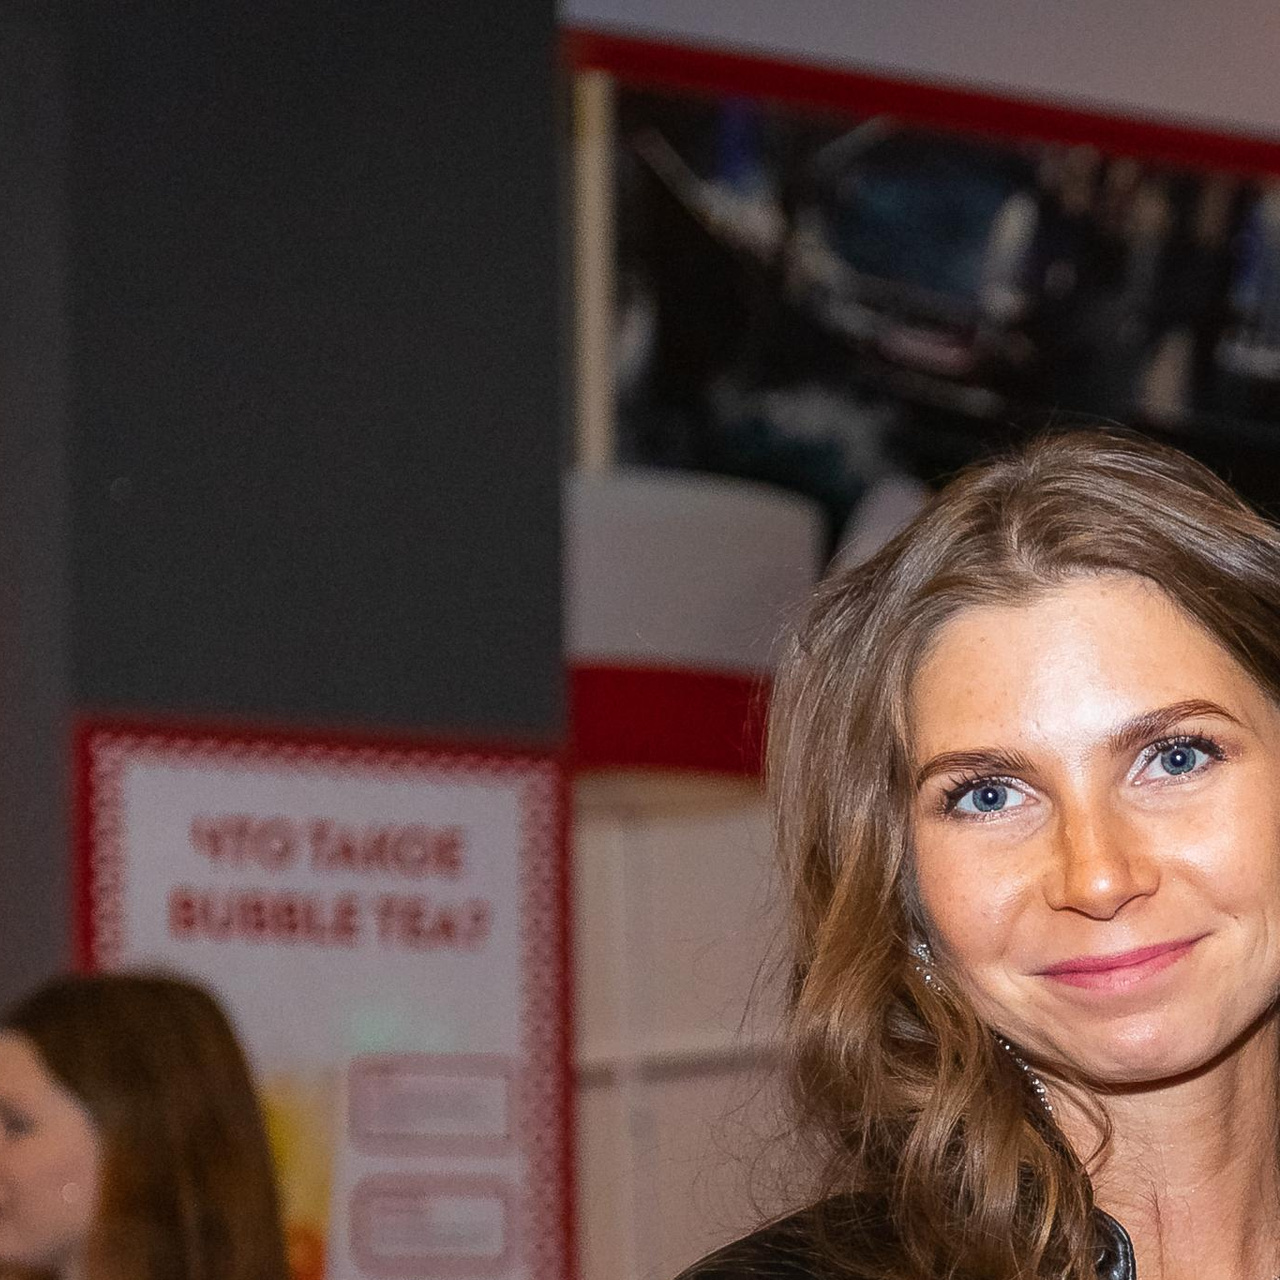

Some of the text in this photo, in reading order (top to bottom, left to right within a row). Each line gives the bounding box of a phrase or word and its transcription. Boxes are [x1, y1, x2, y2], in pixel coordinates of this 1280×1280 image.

[190, 815, 465, 879] ЧТО ТАКОЕ
[170, 888, 358, 945] BUBBLE
